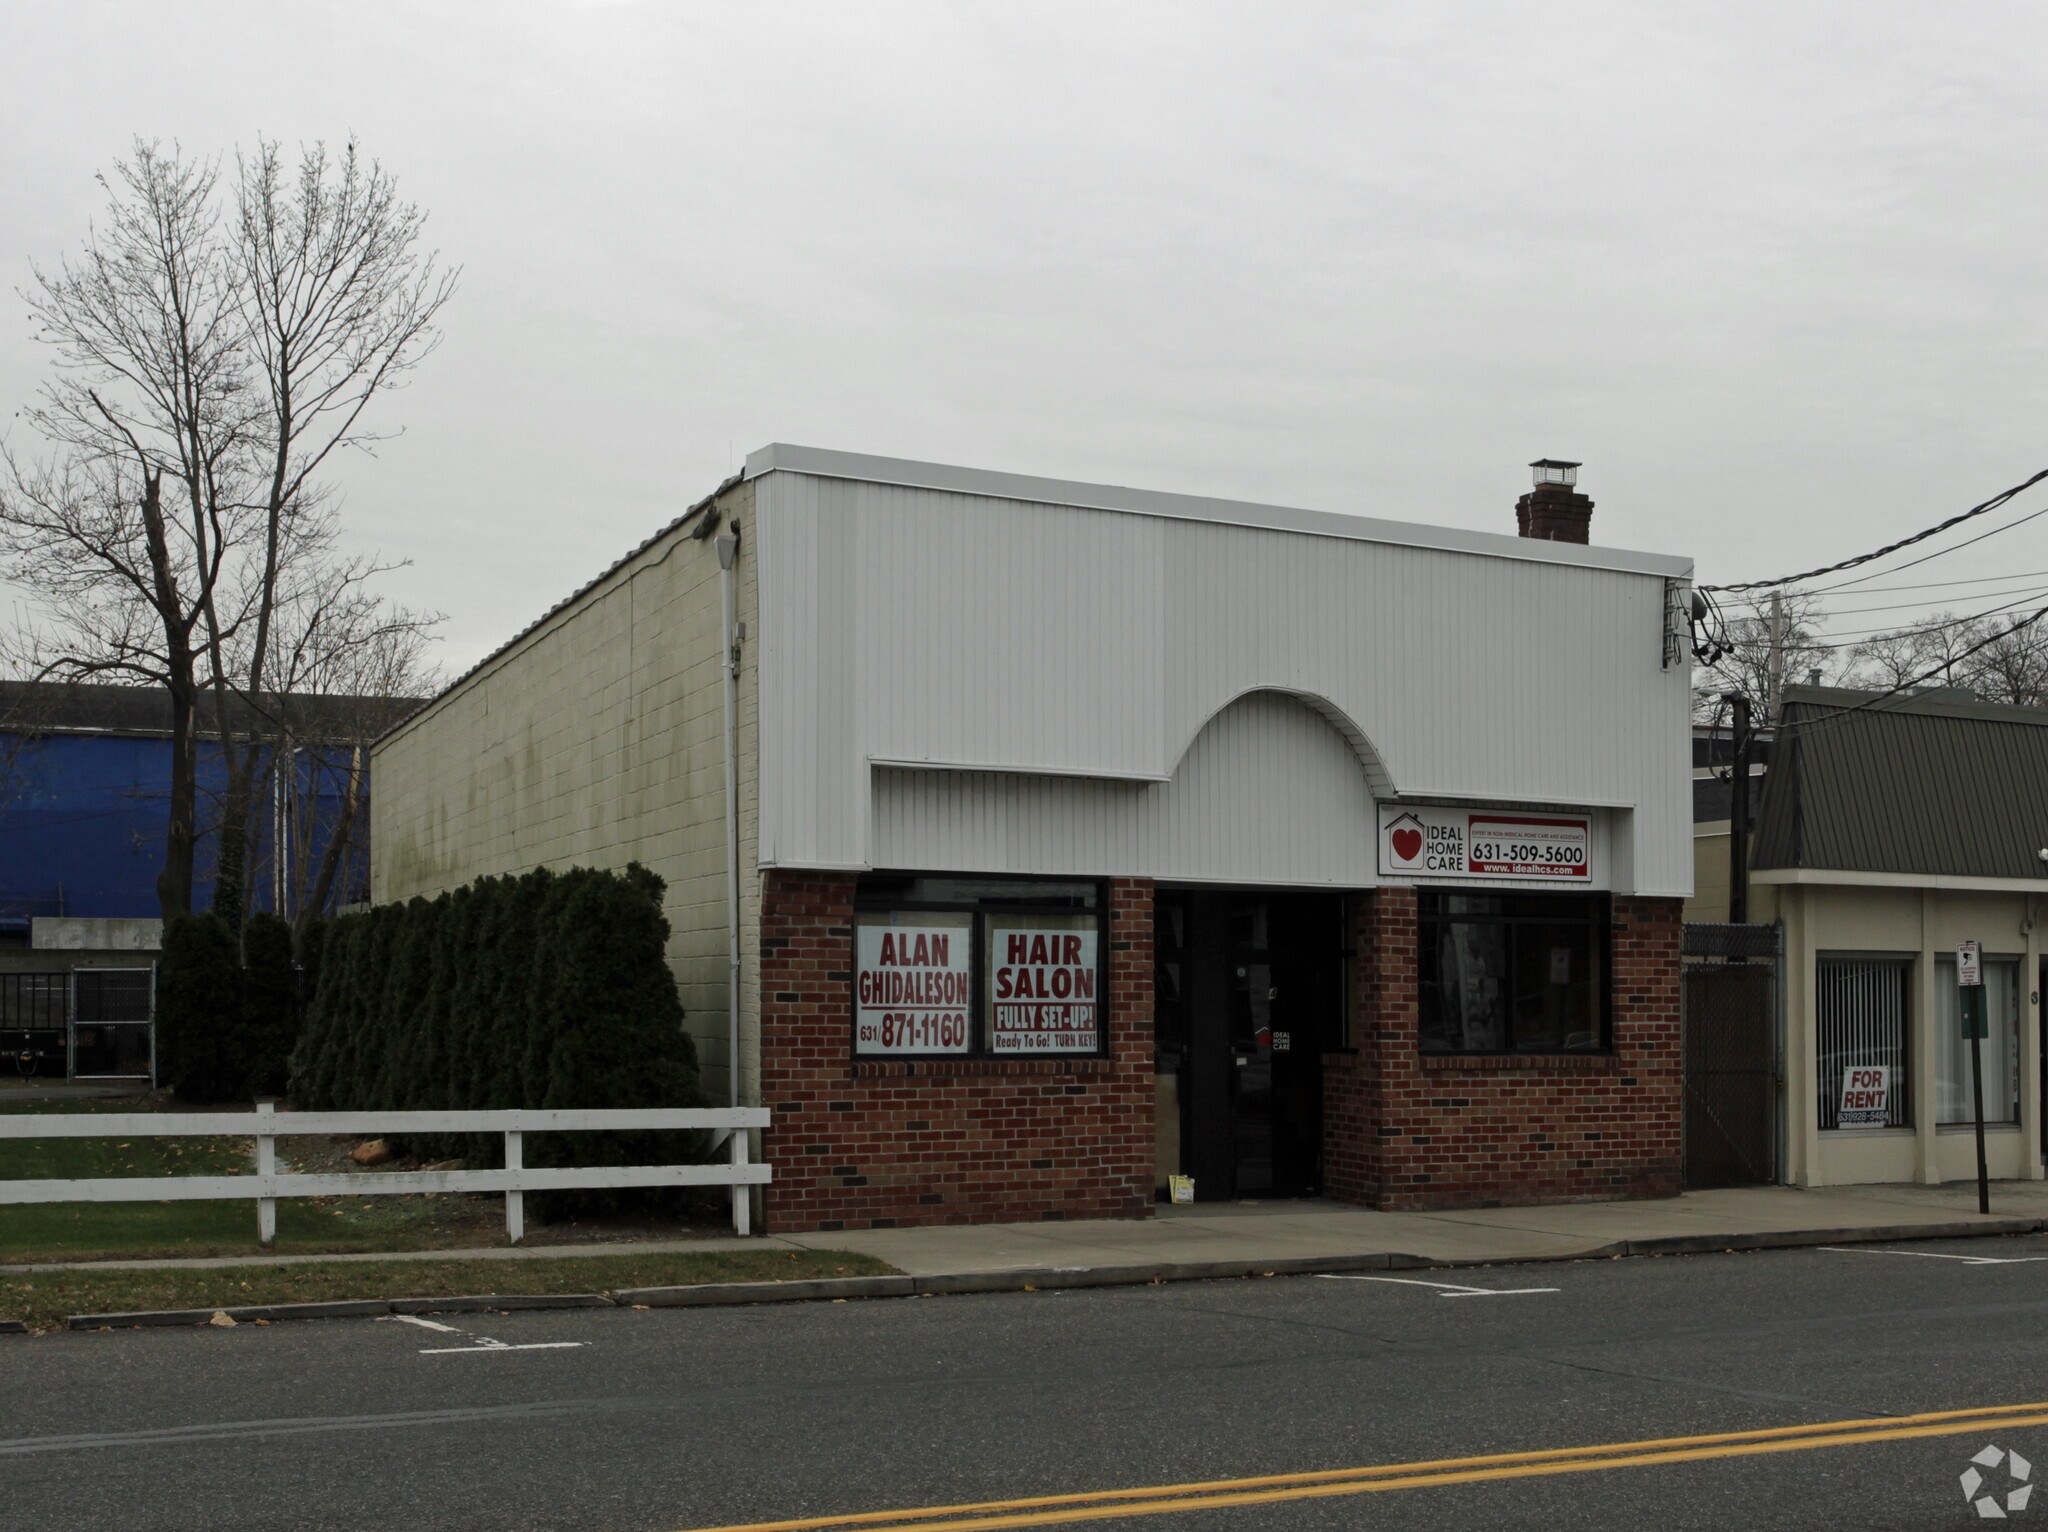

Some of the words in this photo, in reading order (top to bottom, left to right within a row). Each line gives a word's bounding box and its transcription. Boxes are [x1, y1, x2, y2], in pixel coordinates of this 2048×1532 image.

[1426, 825, 1463, 841] IDEAL
[1426, 842, 1463, 855] HOME
[1473, 843, 1583, 863] 631-509-5600
[1426, 856, 1463, 871] CARE
[879, 932, 949, 967] ALAN
[1007, 934, 1082, 965] HAIR
[859, 970, 968, 1005] GHIDALESON
[996, 967, 1094, 999] SALON
[996, 1005, 1038, 1029] FULLY
[1041, 1005, 1093, 1029] SET-UP!
[995, 1034, 1021, 1051] Ready
[1024, 1034, 1034, 1048] To
[1036, 1034, 1050, 1048] Go!
[1054, 1034, 1076, 1048] TURN
[1078, 1034, 1096, 1048] KEY!
[1851, 1070, 1883, 1088] FOR
[1843, 1090, 1886, 1109] RENT
